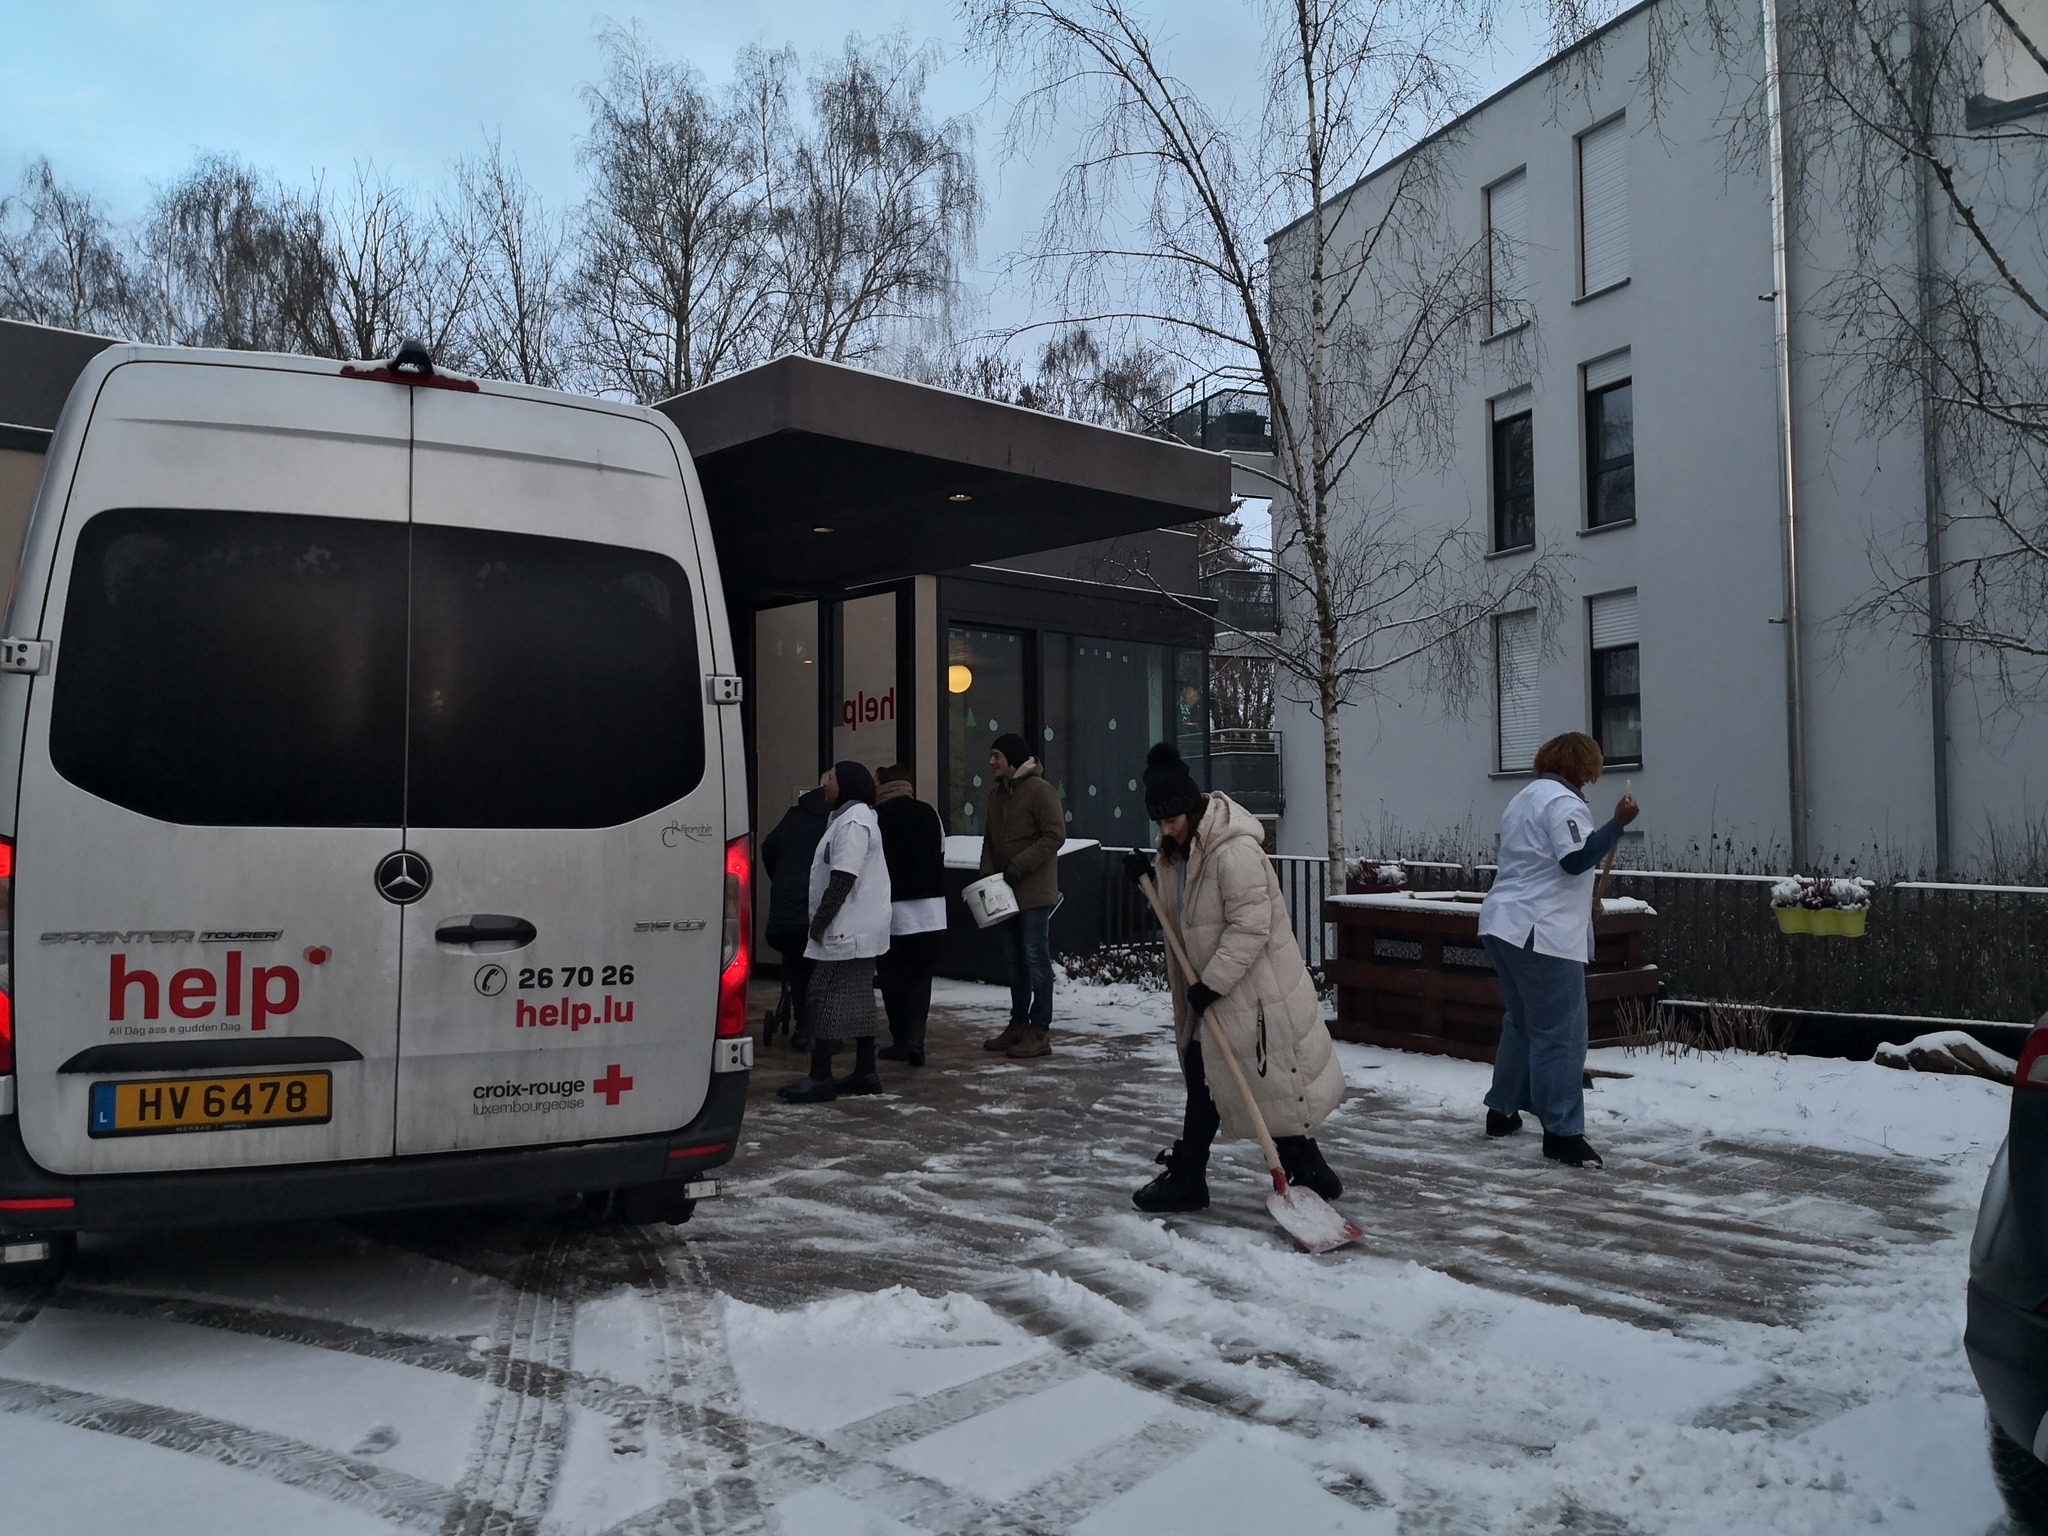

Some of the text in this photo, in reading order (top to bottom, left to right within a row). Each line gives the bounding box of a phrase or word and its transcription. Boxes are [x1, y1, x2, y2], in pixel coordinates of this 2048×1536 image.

[40, 930, 278, 944] SPRINTER TOURER
[518, 965, 635, 989] 26 70 26
[109, 951, 300, 1031] help
[515, 995, 634, 1031] help.lu
[109, 1022, 241, 1037] All Dag ass e gudden Dag
[473, 1079, 585, 1099] croix-rouge
[138, 1081, 308, 1121] HV 6478
[472, 1097, 585, 1116] luxembourgeoise
[100, 1112, 108, 1123] L
